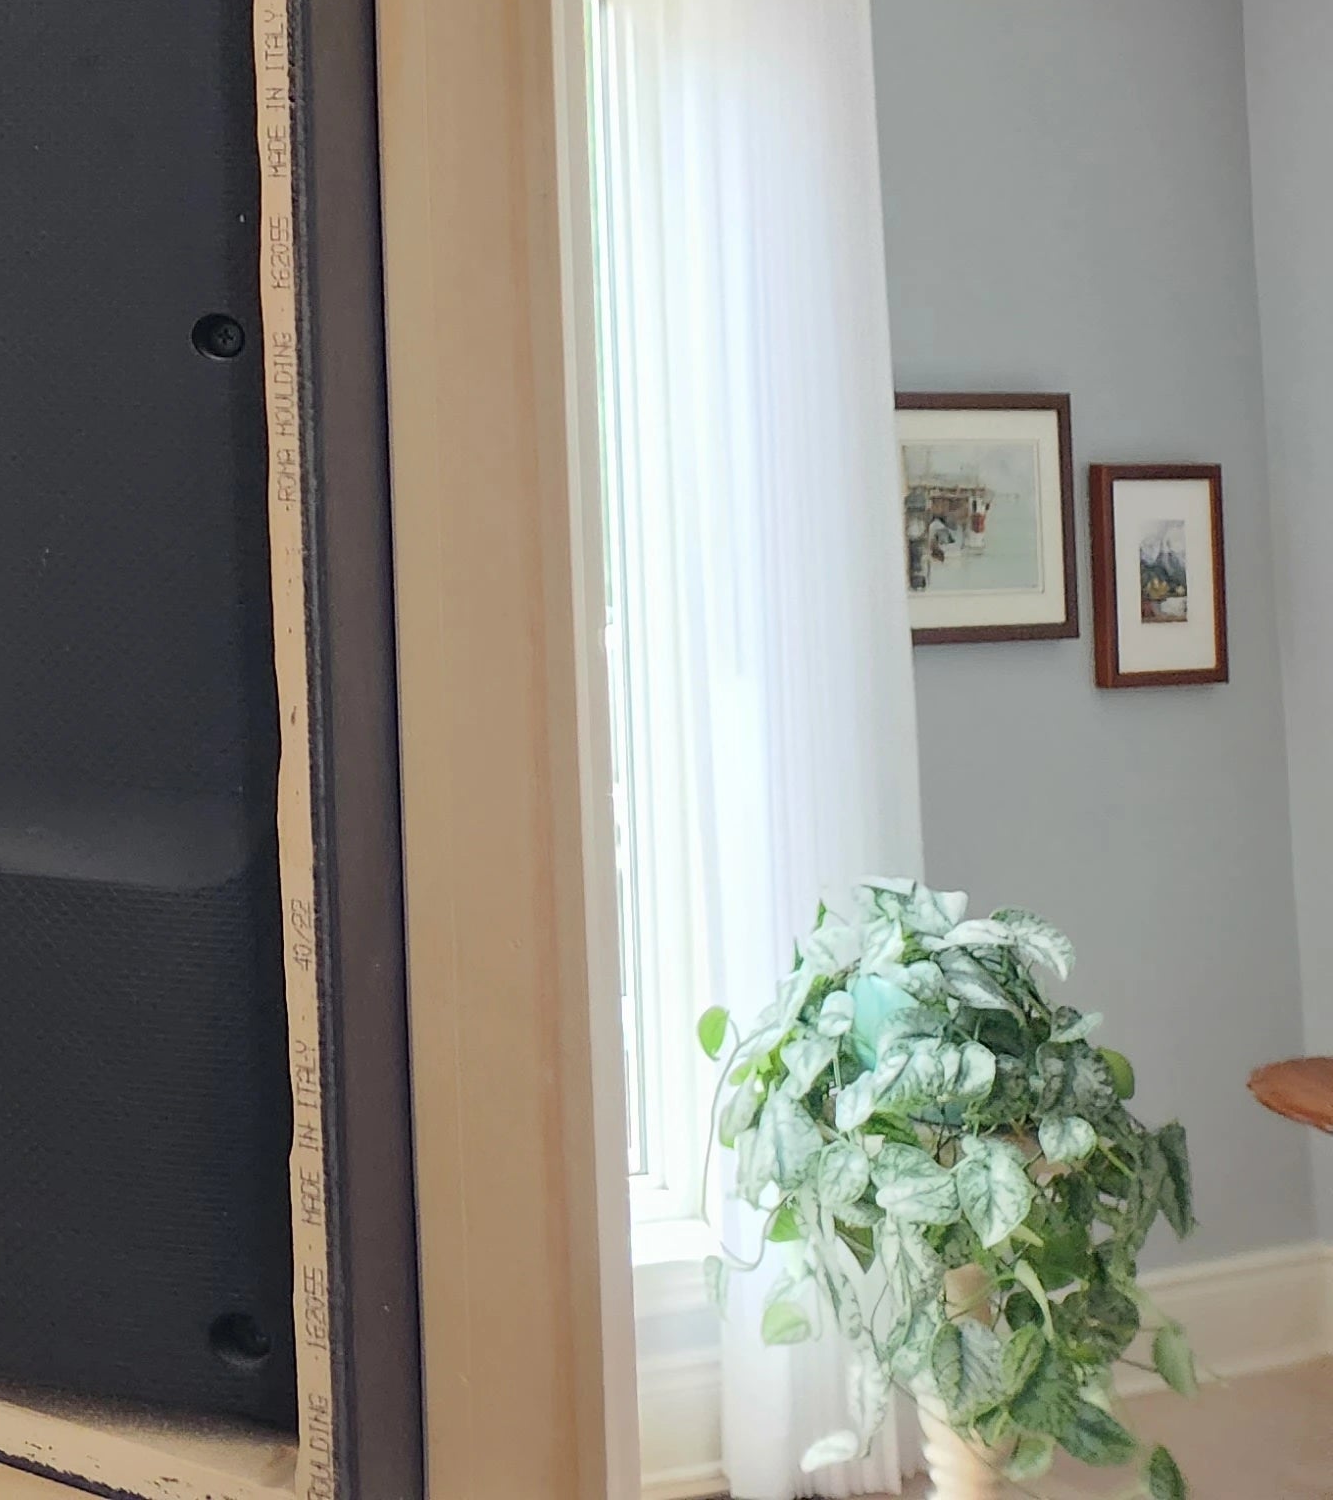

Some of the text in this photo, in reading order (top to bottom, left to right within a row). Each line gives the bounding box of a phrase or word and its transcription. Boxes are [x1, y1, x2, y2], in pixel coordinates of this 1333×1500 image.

[264, 9, 285, 72] ITALY
[265, 87, 286, 110] IN
[266, 124, 287, 178] MADE
[269, 216, 291, 290] 162055
[272, 332, 295, 437] MOULDING
[276, 448, 297, 503] ROMA
[290, 898, 313, 971] 40/22
[294, 1040, 317, 1111] ITALY
[298, 1123, 319, 1153] IN
[299, 1166, 323, 1226] MADE
[303, 1264, 327, 1351] 162055
